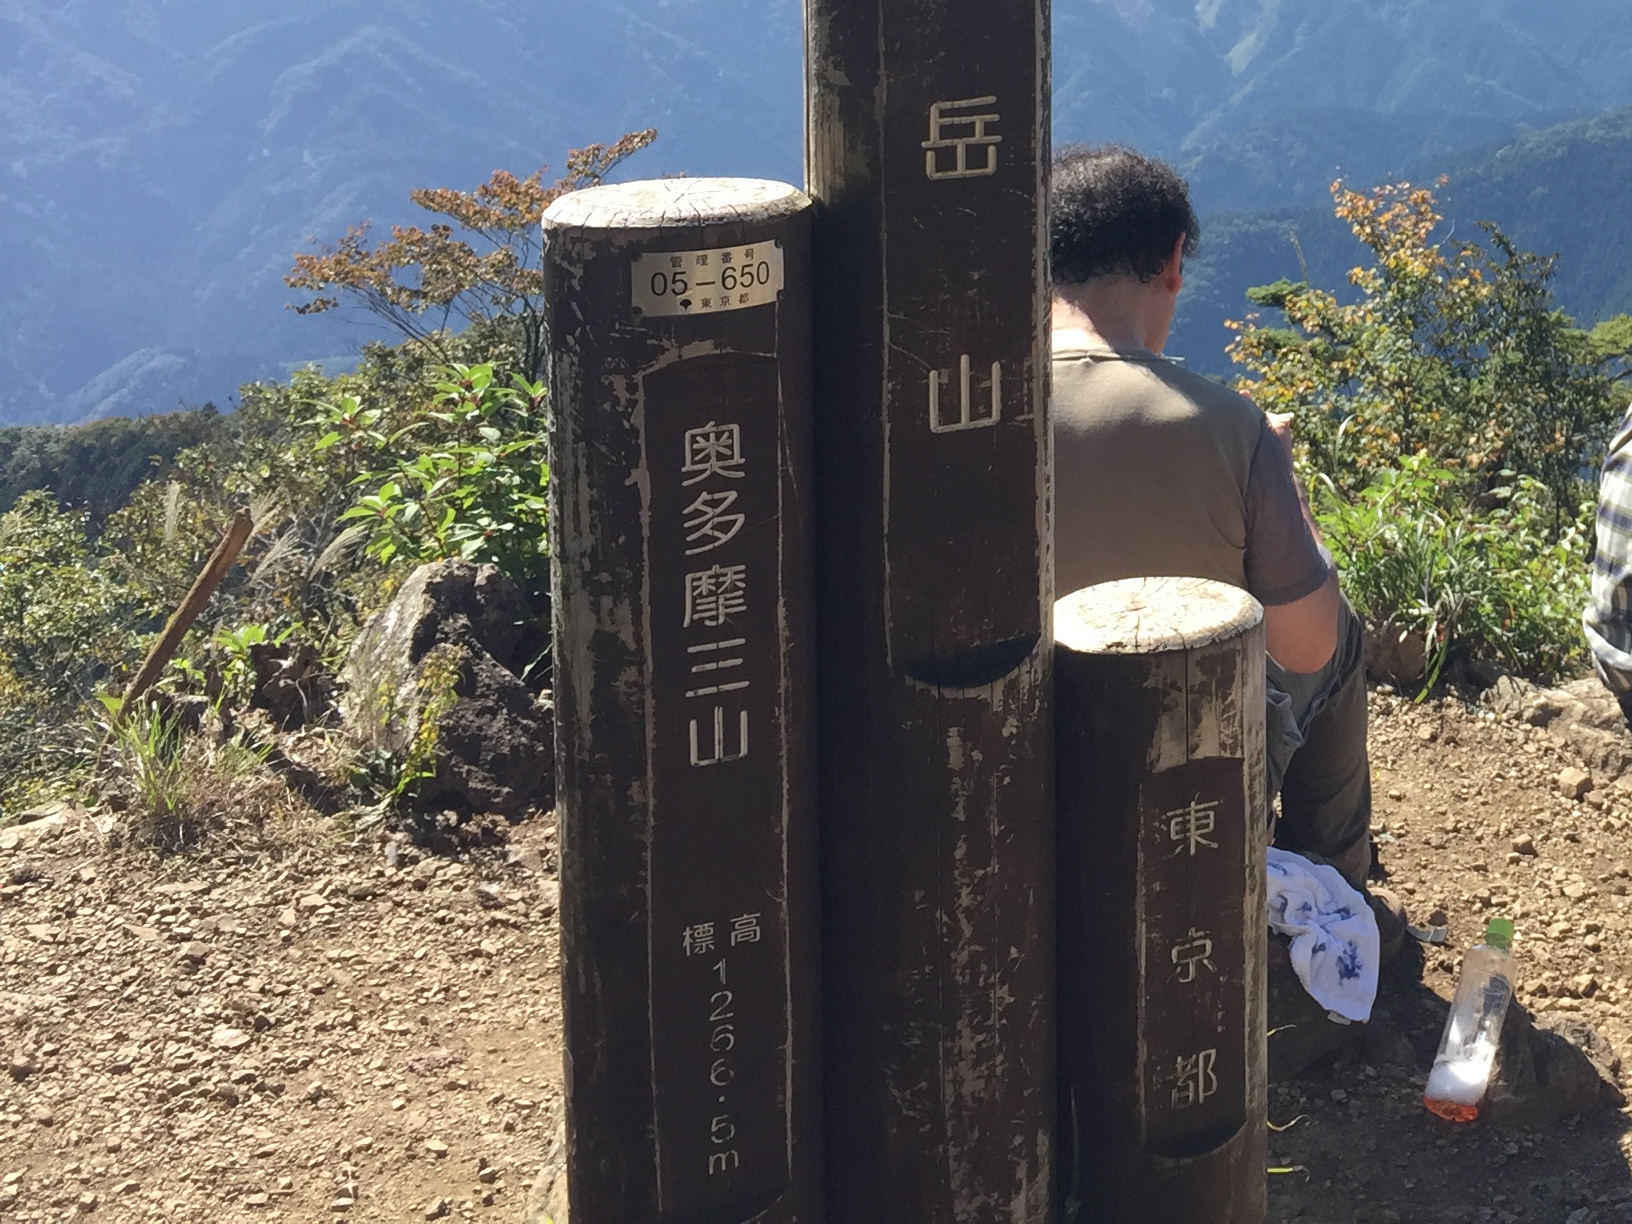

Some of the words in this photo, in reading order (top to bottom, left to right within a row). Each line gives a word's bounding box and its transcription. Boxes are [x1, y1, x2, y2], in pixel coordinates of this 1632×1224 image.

[670, 248, 755, 268] 管理番号
[700, 292, 750, 310] 東京都
[681, 421, 750, 766] 奥多摩三山
[1164, 798, 1220, 1108] 東京都
